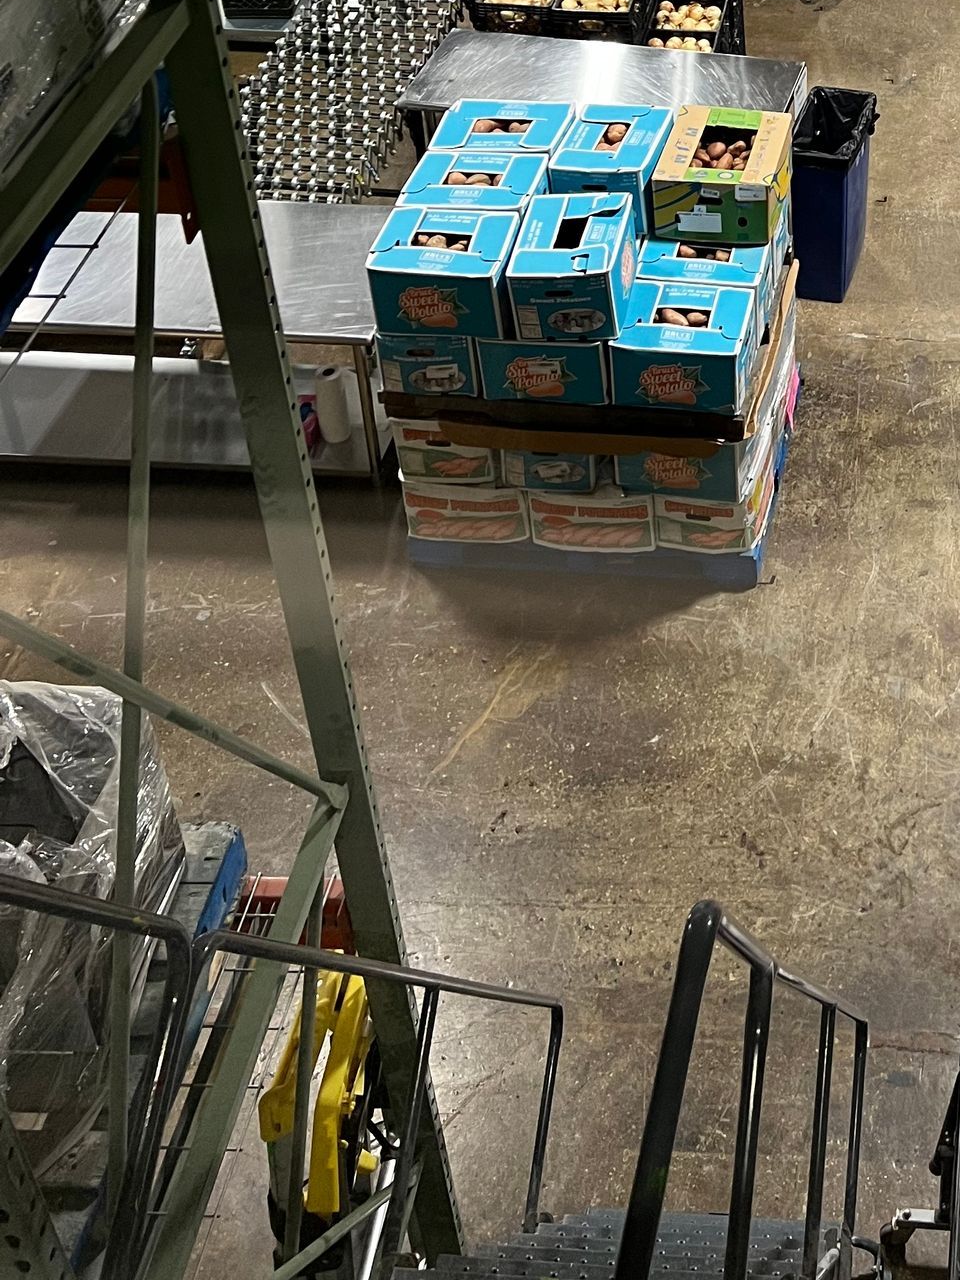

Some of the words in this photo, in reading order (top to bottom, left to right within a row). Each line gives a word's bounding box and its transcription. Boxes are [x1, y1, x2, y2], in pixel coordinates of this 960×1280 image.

[401, 293, 439, 308] Sweet
[409, 303, 451, 318] Potato
[642, 371, 681, 385] Sweet
[649, 381, 693, 395] Potato
[655, 467, 696, 481] Potato
